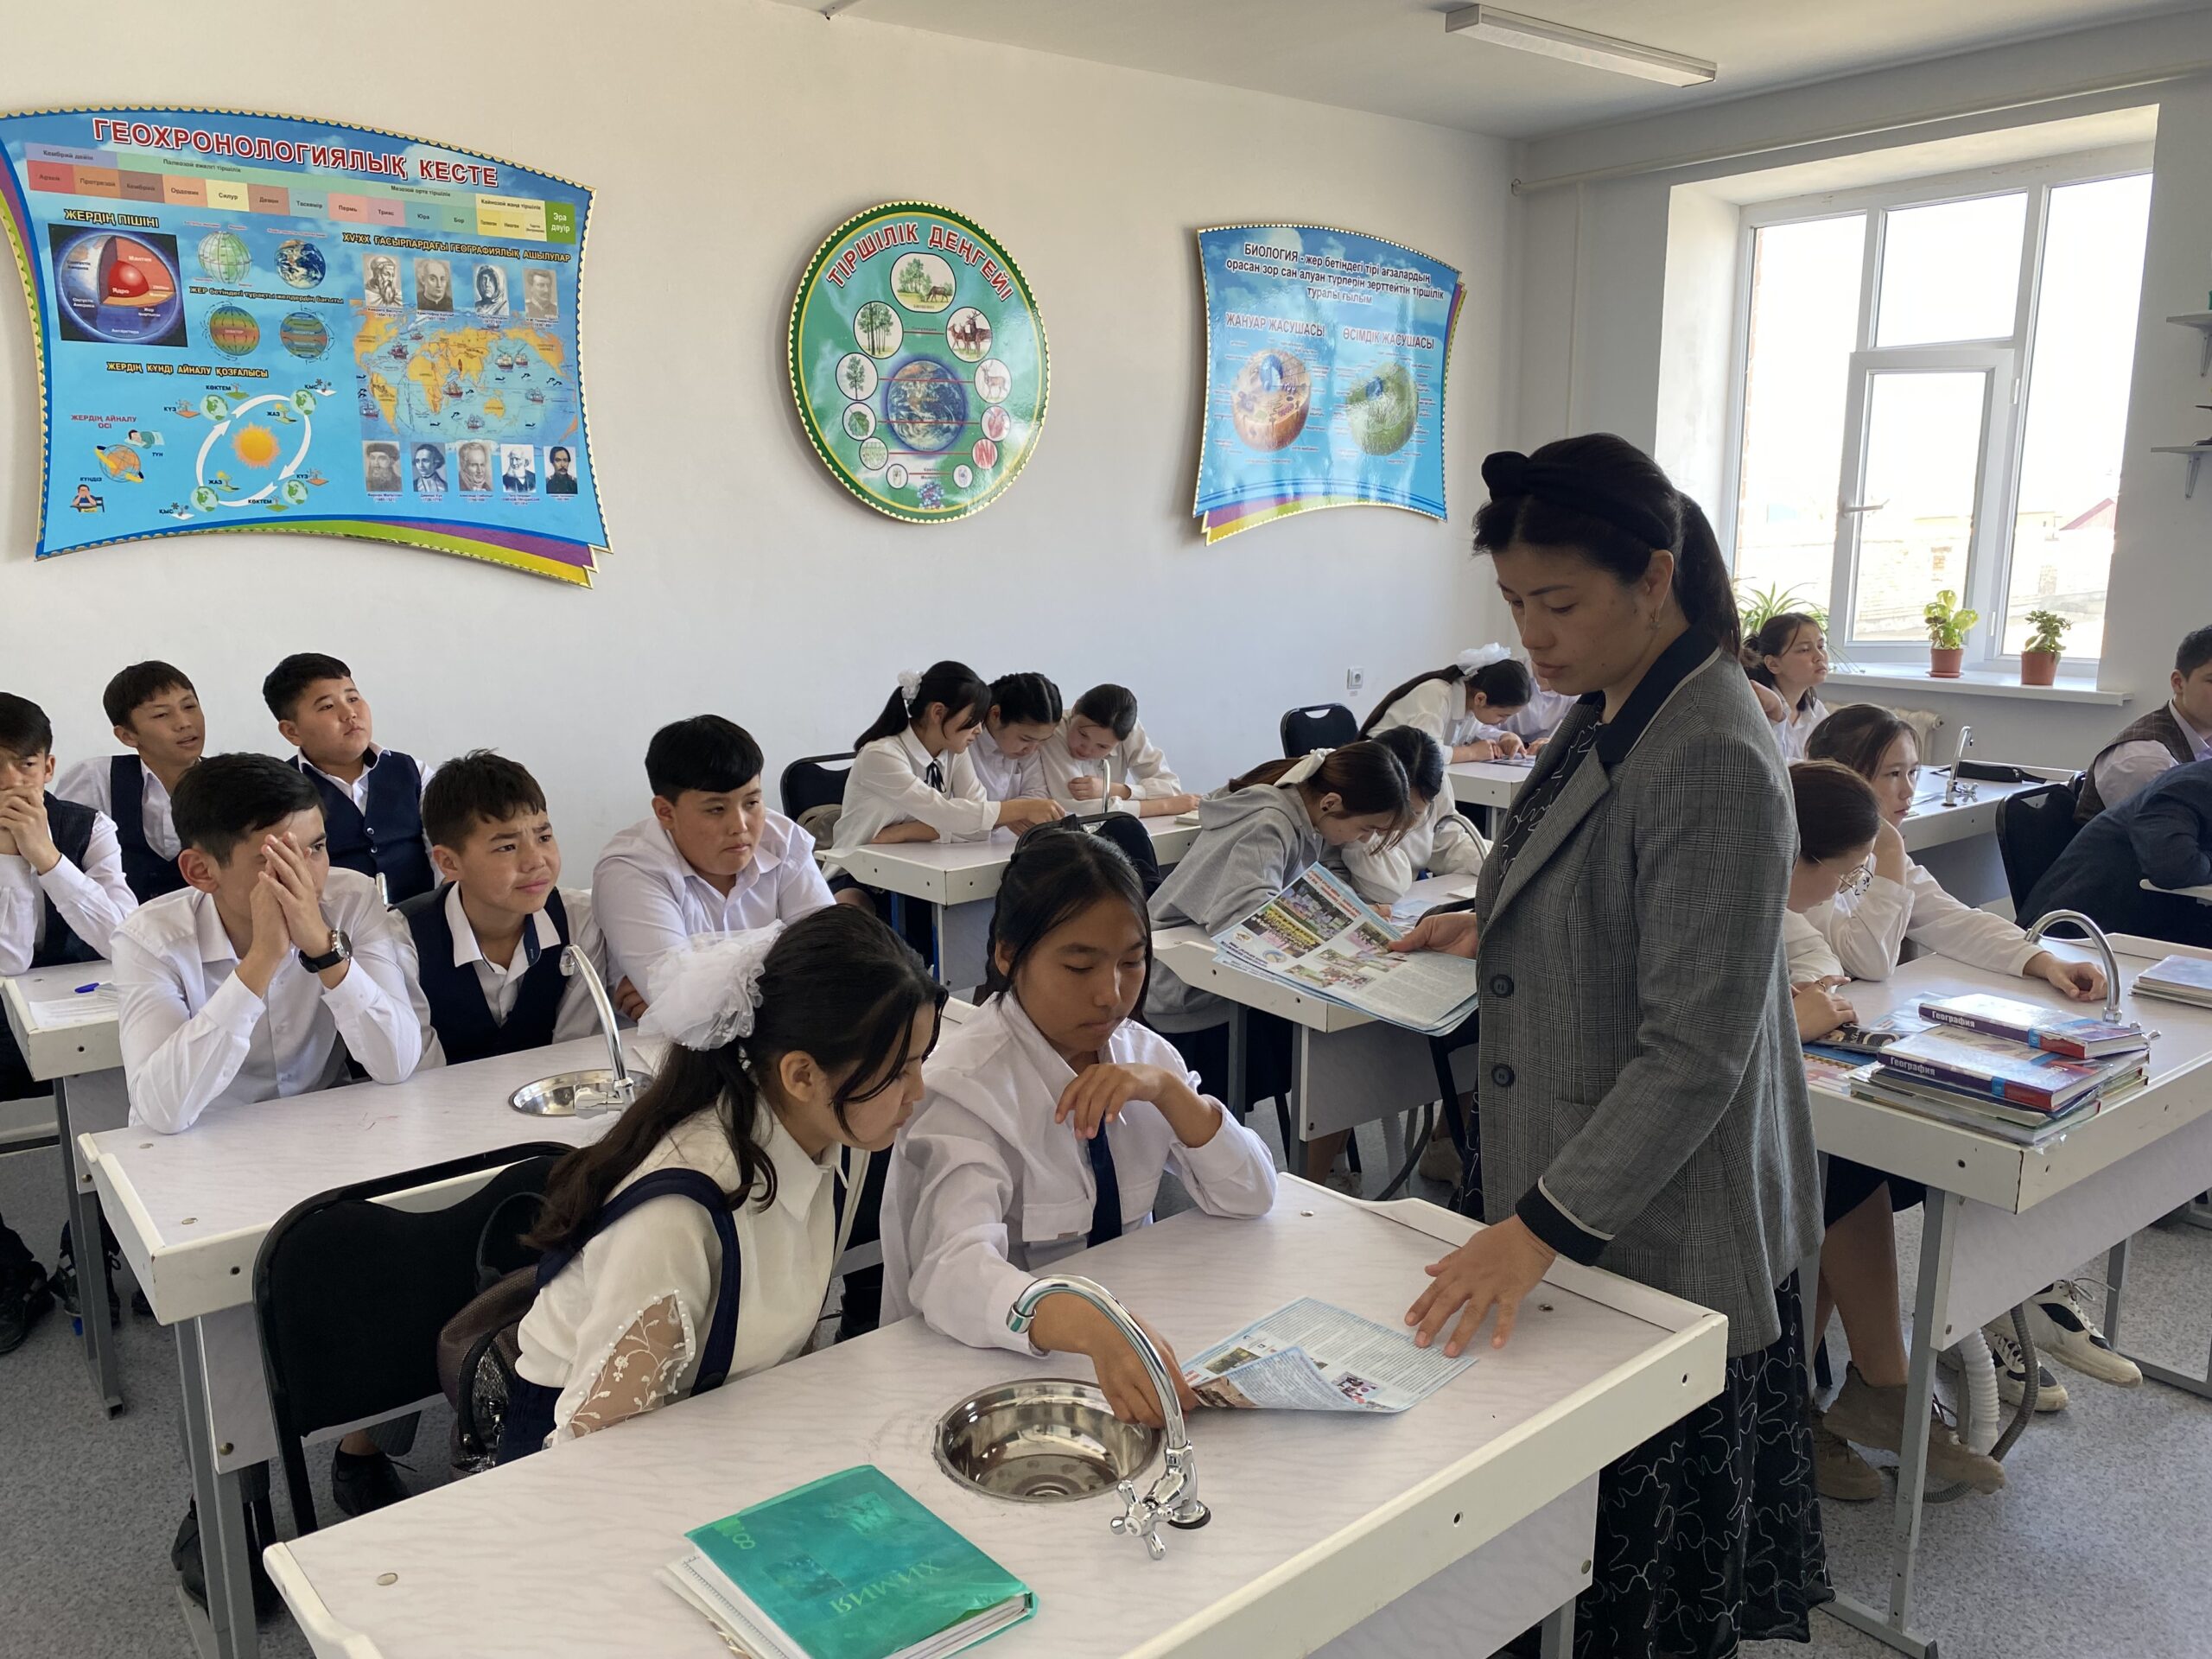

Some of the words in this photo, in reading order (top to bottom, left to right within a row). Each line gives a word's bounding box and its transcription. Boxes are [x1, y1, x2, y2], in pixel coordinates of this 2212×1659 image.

[92, 118, 409, 181] ГЕОХРОНОЛОГИЯЛЫҚ
[418, 158, 499, 188] КЕСТЕ
[218, 192, 238, 200] Силур
[63, 208, 117, 226] ЖЕРДІҢ
[117, 213, 159, 228] ПІШІНІ
[553, 212, 567, 222] Эра
[373, 235, 448, 252] ҒАСЫРЛАРДАҒЫ
[449, 243, 521, 260] ГЕОГРАФИЯЛЫҚ
[522, 250, 572, 264] АШЫЛУЛАР
[827, 222, 919, 288] ТІРШІЛІК
[928, 225, 1014, 301] ДЕҢГЕЙІ
[1244, 243, 1299, 262] БИОЛОГИЯ
[1306, 255, 1323, 269] жер
[1325, 257, 1363, 272] бетіндегі
[1365, 263, 1380, 276] тірі
[1382, 266, 1431, 284] ағзалардың
[1226, 260, 1261, 272] орасан
[1262, 265, 1279, 277] зор
[1281, 269, 1298, 278] сан
[1300, 271, 1325, 283] алуан
[1327, 275, 1365, 289] түрлерін
[1367, 278, 1410, 296] зерттейтін
[1413, 283, 1445, 300] тіршілік
[189, 286, 208, 295] ЖЕР
[1307, 286, 1340, 301] туралы
[1342, 292, 1372, 305] ғылым
[1225, 311, 1267, 329] ЖАНУАР
[1268, 318, 1325, 337] ЖАСУШАСЫ
[1343, 327, 1381, 343] ӨСІМДІК
[1382, 331, 1434, 350] ЖАСУШАСЫ
[106, 361, 143, 373] ЖЕРДІҢ
[146, 363, 174, 375] КҮНДІ
[177, 364, 212, 375] АЙНАЛУ
[215, 366, 270, 378] ҚОЗҒАЛЫСЫ
[71, 414, 104, 423] ЖЕРДІҢ
[1931, 1009, 1976, 1028] География
[1890, 1057, 1936, 1077] География
[732, 1532, 756, 1551] 8
[830, 1557, 944, 1616] ХИМИЯ
